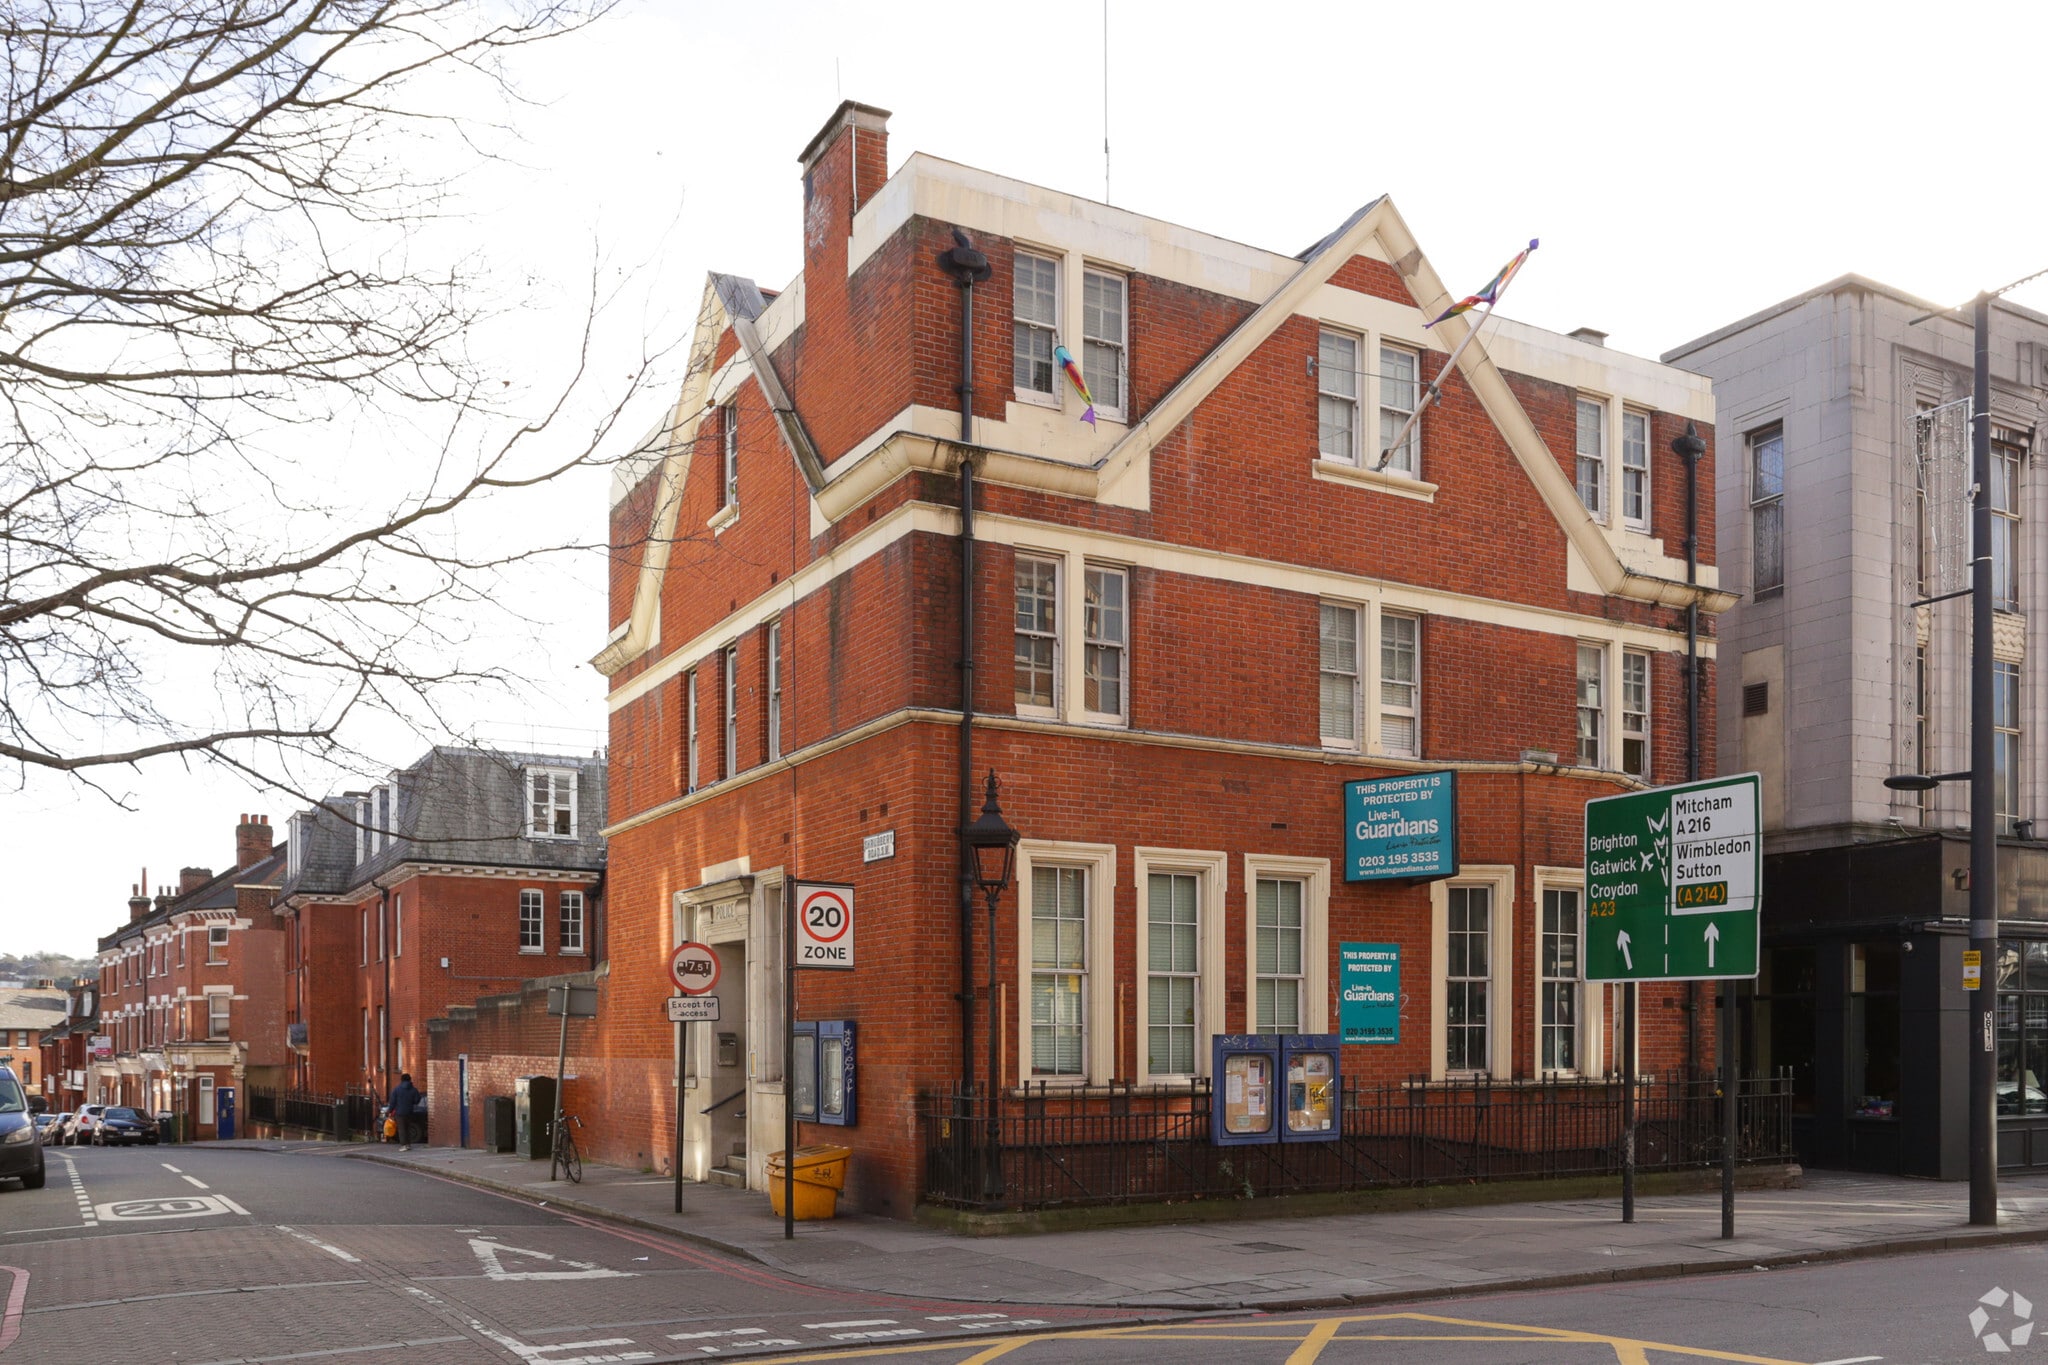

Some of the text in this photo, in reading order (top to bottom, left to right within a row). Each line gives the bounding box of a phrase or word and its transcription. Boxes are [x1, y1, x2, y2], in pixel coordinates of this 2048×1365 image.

[1355, 777, 1441, 795] THIS PROPERTY IS
[1363, 790, 1433, 806] PROTECTED BY
[1676, 796, 1732, 815] Mitcham
[1368, 809, 1400, 821] Live-in
[1356, 818, 1438, 839] Guardians
[1590, 834, 1638, 853] Brighton
[1677, 840, 1751, 860] Wimbledon
[1358, 851, 1439, 867] 0203 195 3535
[1590, 857, 1637, 876] Gatwick
[1676, 863, 1722, 880] Sutton
[1590, 881, 1638, 900] Croydon
[716, 903, 735, 920] POLICE
[809, 906, 842, 928] 20
[804, 946, 847, 960] ZONE
[1359, 952, 1389, 960] PROPERTY
[1390, 952, 1397, 960] IS
[1348, 964, 1392, 972] PROTECTED BY
[1343, 989, 1395, 1001] Guardians
[671, 1000, 716, 1011] Except for
[680, 1009, 709, 1017] access
[1345, 1027, 1359, 1035] 020
[115, 1201, 205, 1215] 20
